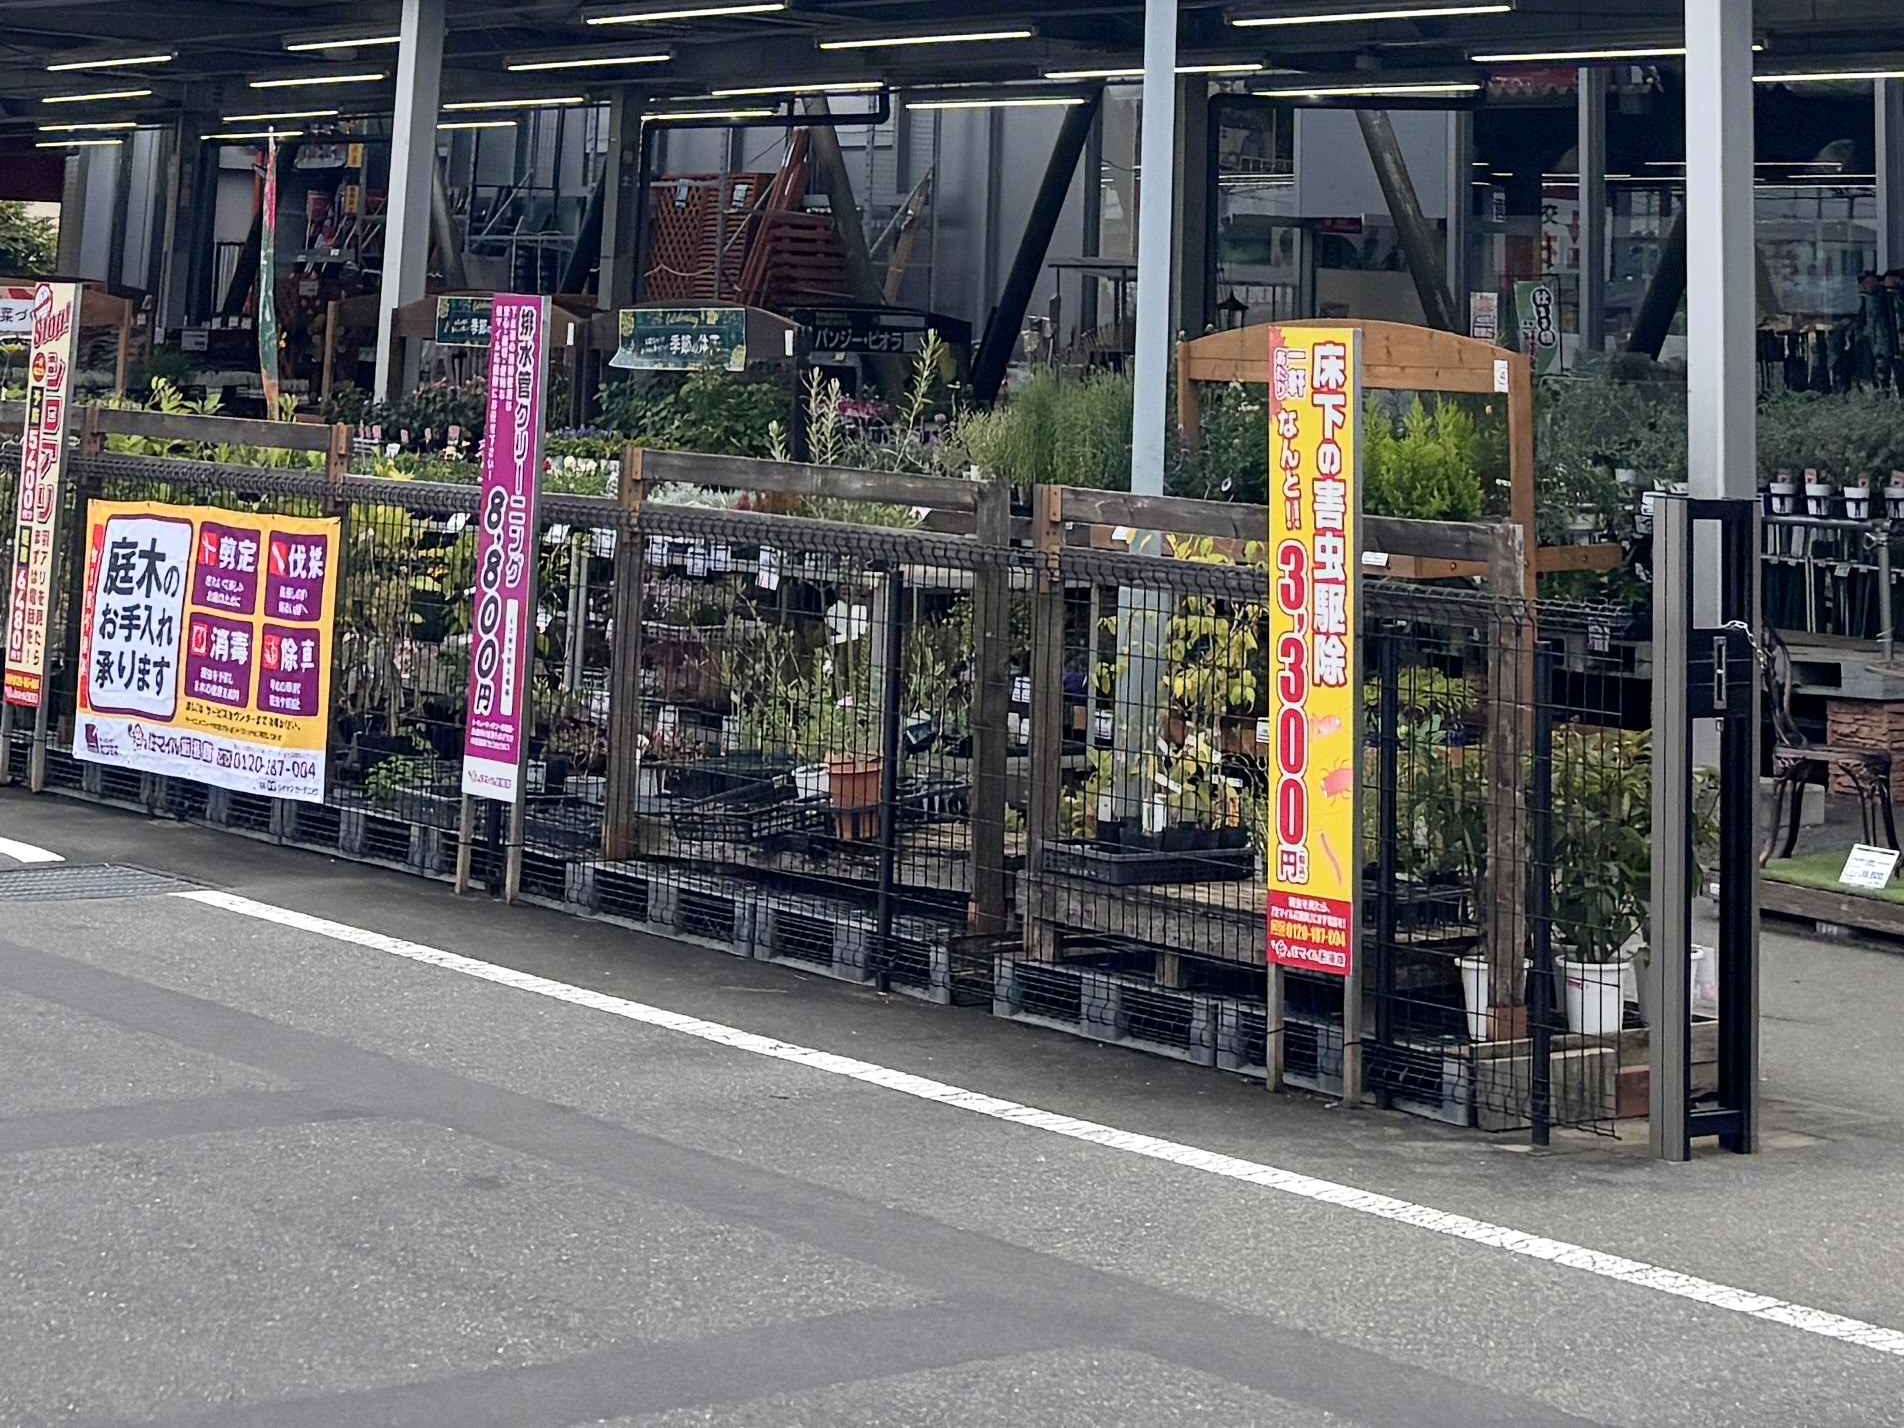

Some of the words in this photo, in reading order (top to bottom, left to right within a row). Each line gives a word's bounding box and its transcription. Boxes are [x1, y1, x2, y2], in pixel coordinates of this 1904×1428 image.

[505, 307, 537, 588] 排水管クリーニング
[1311, 342, 1347, 688] 床下の害虫駆除
[102, 537, 180, 599] 庭木の
[98, 603, 174, 648] お手入れ
[209, 626, 250, 666] 消毒
[94, 650, 172, 696] 承ります
